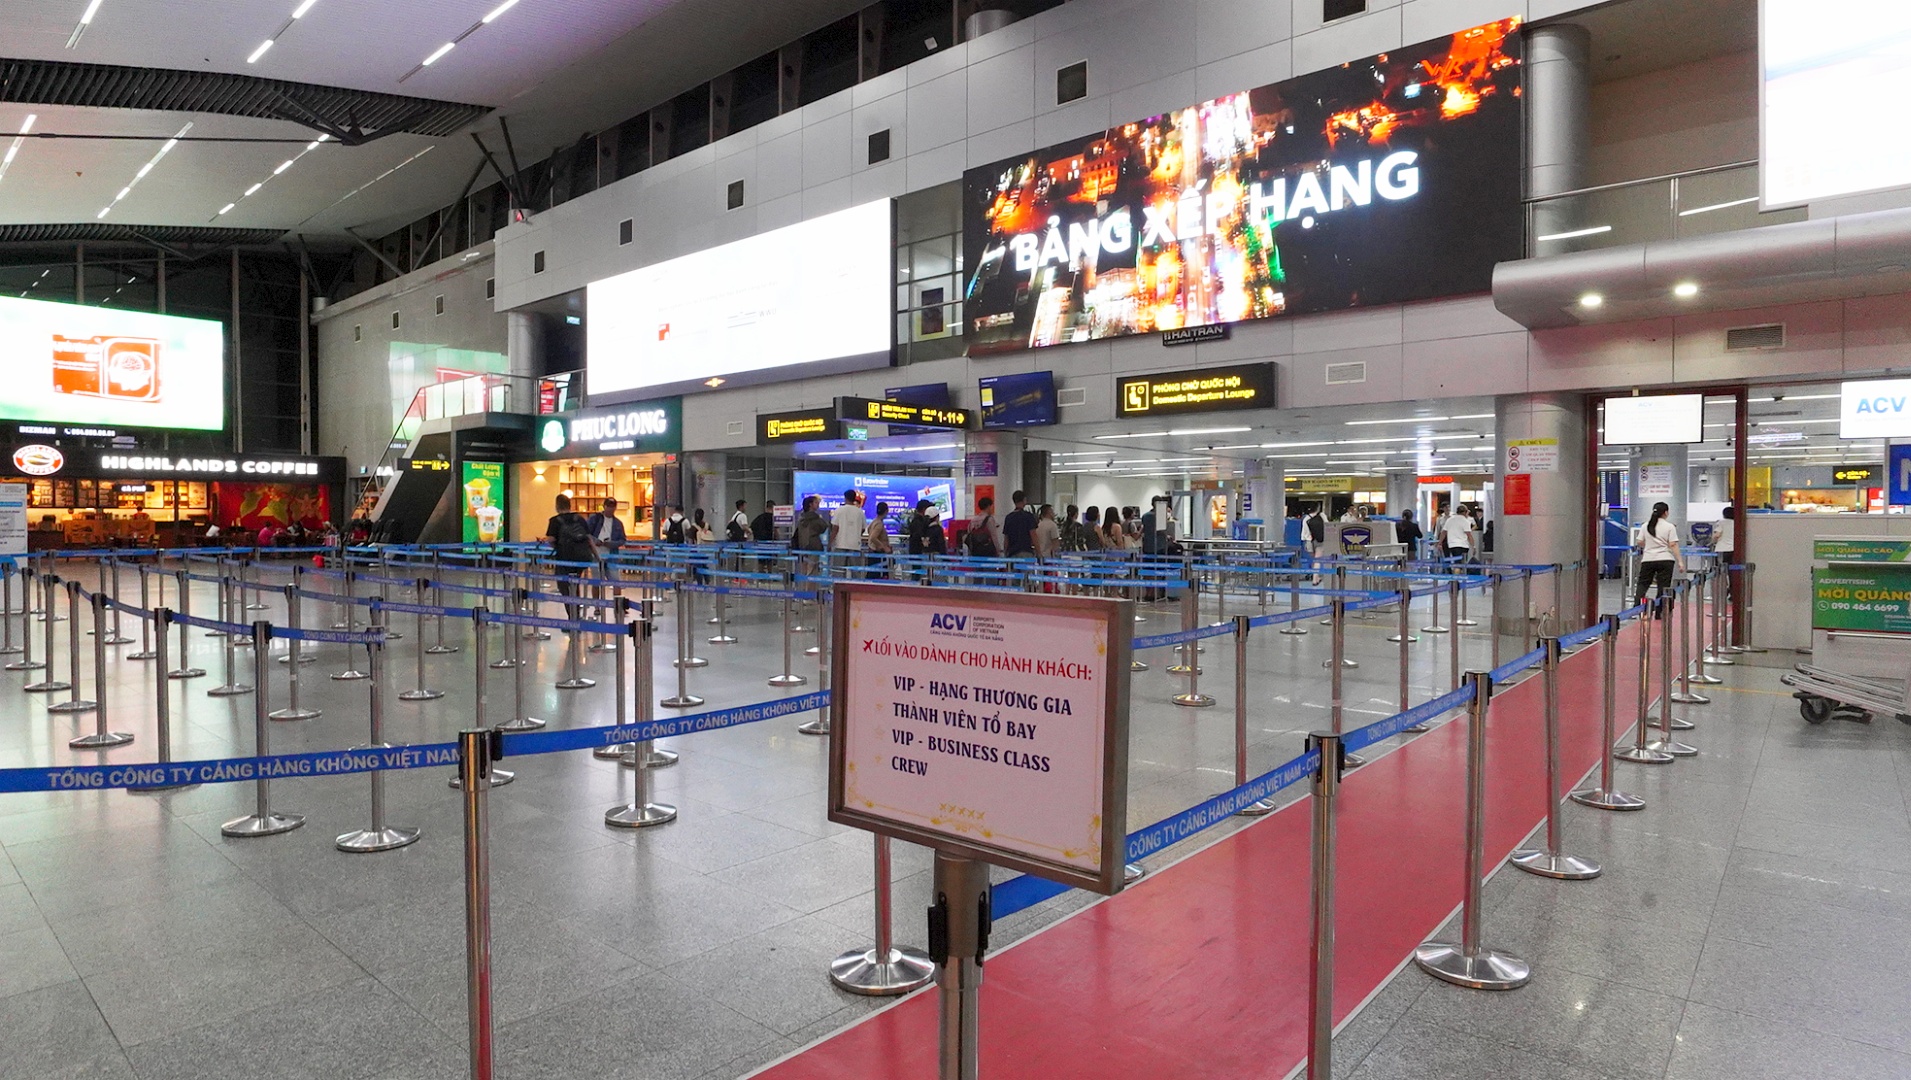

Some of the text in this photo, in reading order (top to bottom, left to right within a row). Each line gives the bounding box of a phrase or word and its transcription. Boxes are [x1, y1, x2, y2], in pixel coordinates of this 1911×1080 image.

[1012, 150, 1419, 272] BẢNG XẾP HẠNG
[1152, 389, 1255, 405] Domestic Departure Lounge
[1856, 396, 1907, 414] ACV
[616, 409, 667, 437] LONG
[101, 455, 318, 475] HIGHLANDS COFFEE
[1818, 586, 1850, 598] MỜI
[1831, 602, 1850, 610] 090
[1874, 604, 1900, 612] 6699
[930, 613, 968, 630] ACV
[875, 635, 1092, 680] LỐI VÀO DÀNH CHO HÀNH KHÁCH:
[894, 676, 915, 692] VIP
[930, 680, 968, 700] HẠNG
[973, 688, 1038, 711] THƯƠNG
[1044, 697, 1072, 716] GIA
[642, 722, 676, 739] CÔNG
[678, 721, 694, 734] TY
[696, 713, 728, 731] CẢNG
[730, 708, 761, 724] HÀNG
[763, 702, 797, 718] KHÔNG
[799, 695, 820, 711] VIỆT
[892, 701, 1037, 740] THÀNH VIÊN TỔ BAY
[109, 766, 165, 785] CÔNG
[169, 767, 195, 782] TY
[258, 758, 311, 776] HÀNG
[315, 752, 379, 772] KHÔNG
[383, 749, 422, 769] VIỆT
[892, 729, 914, 746] VIP
[928, 736, 998, 763] BUSINESS
[1004, 750, 1051, 773] CLASS
[892, 756, 928, 776] CREW
[1129, 833, 1162, 859] CÔNG
[1163, 823, 1177, 843] TY
[1179, 811, 1206, 837] CẢNG
[1208, 800, 1234, 823] HÀNG
[1236, 782, 1265, 808] KHÔNG
[1266, 773, 1283, 793] VIỆT
[1284, 765, 1301, 784] NAM
[1306, 753, 1320, 773] CTC
